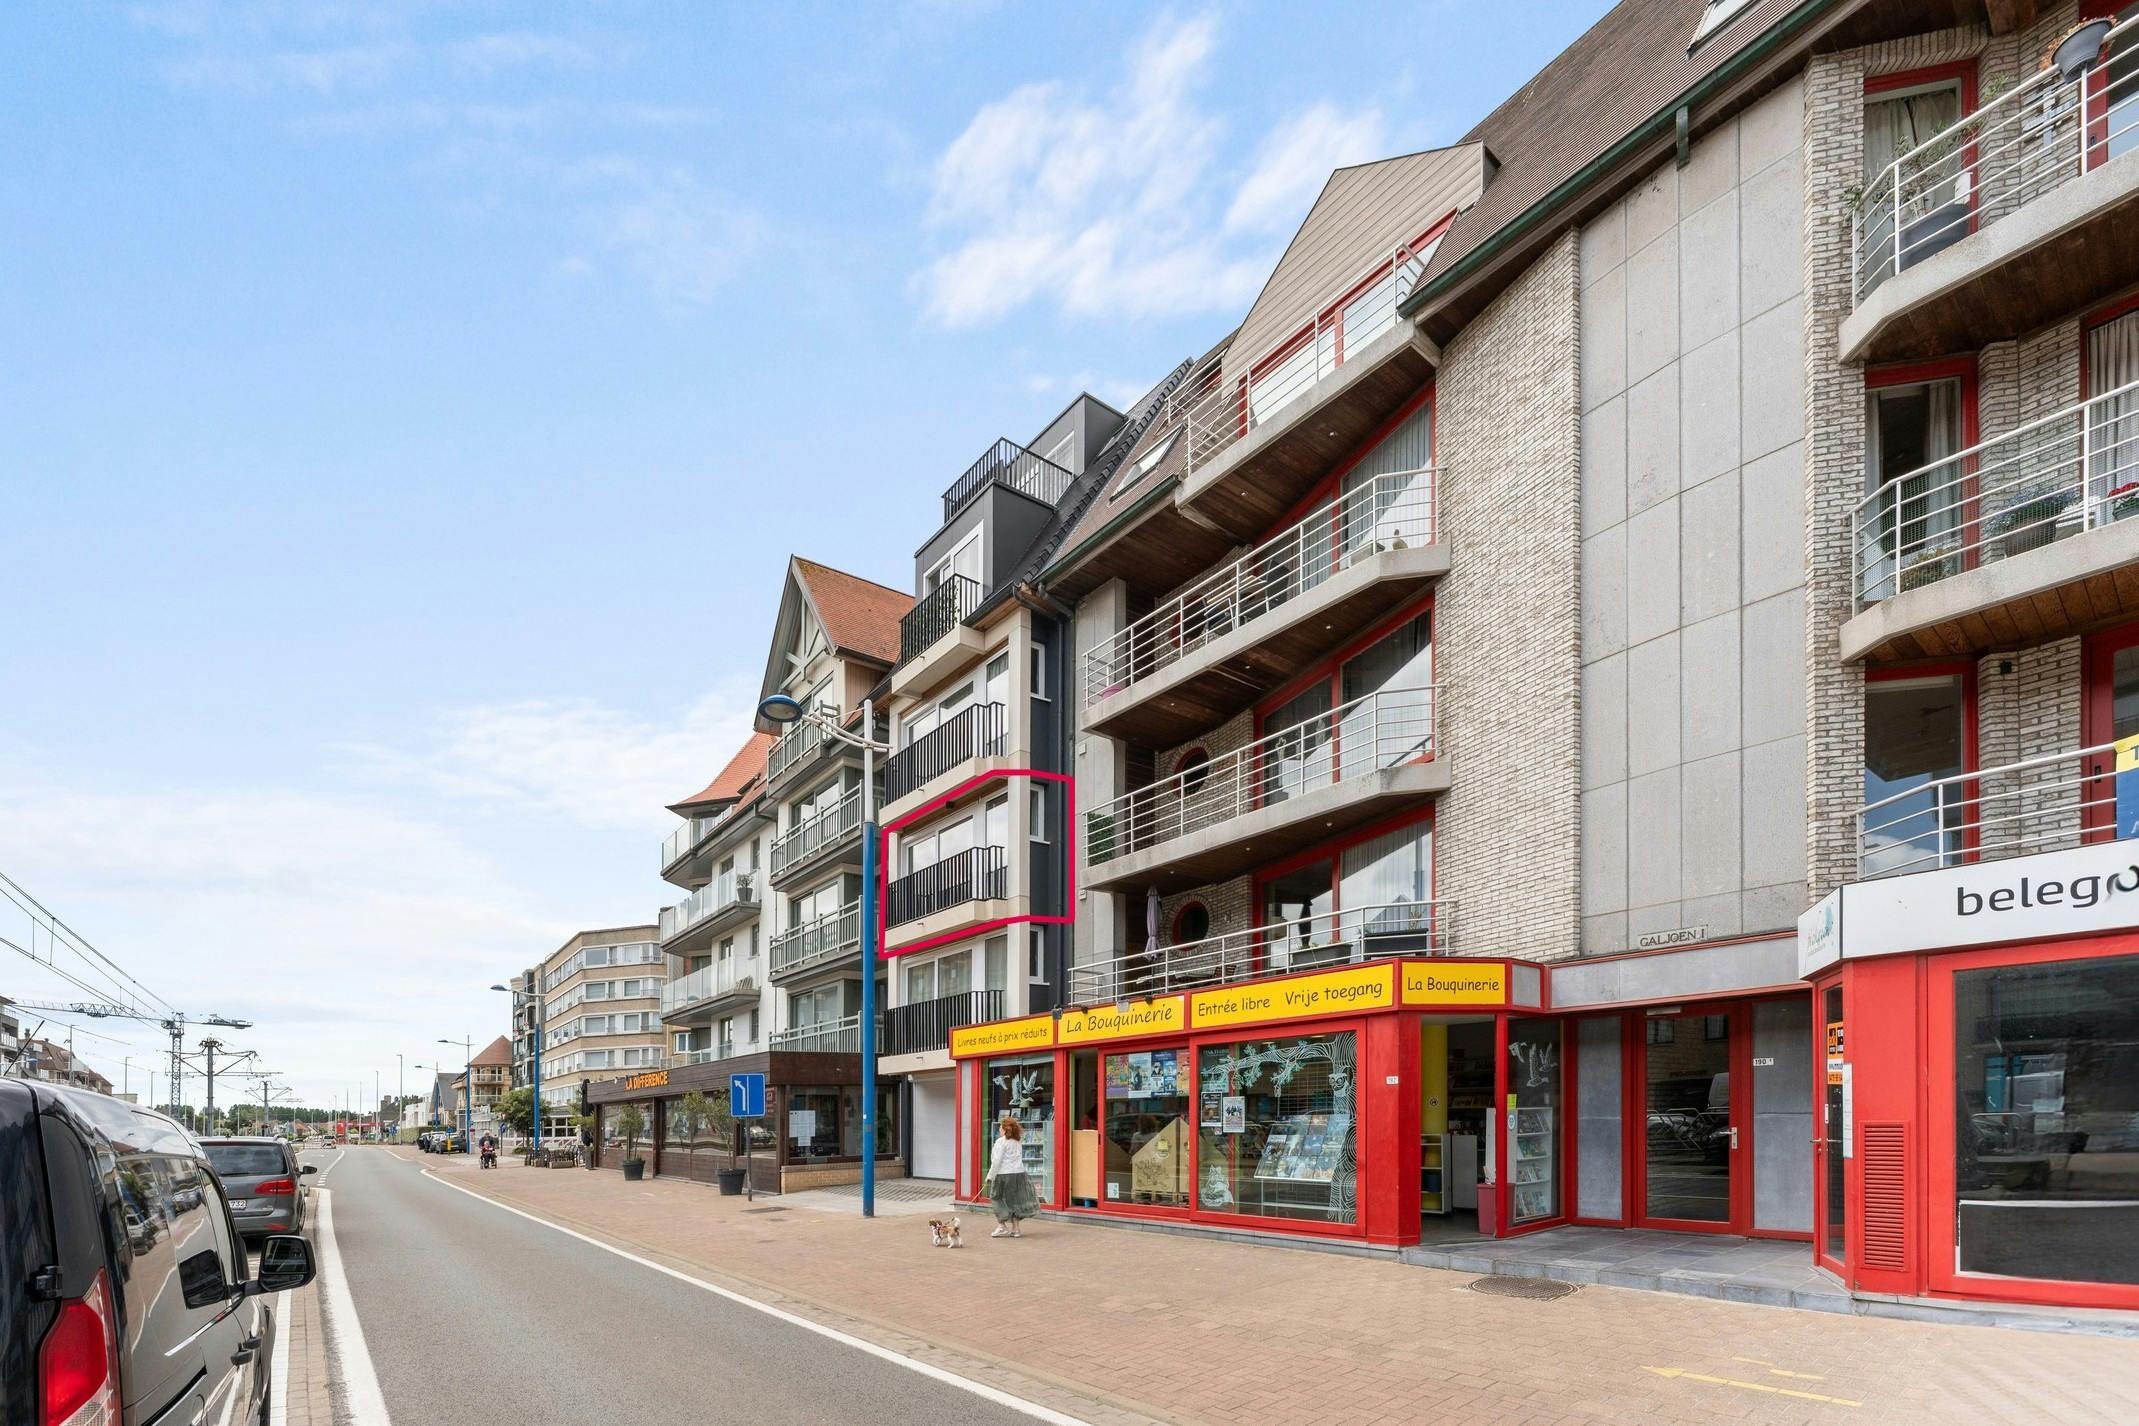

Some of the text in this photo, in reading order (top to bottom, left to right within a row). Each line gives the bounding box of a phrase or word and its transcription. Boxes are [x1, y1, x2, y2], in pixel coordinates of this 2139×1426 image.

[1640, 930, 1696, 946] GALJOEN
[1408, 976, 1500, 994] La Bouquinerie
[1198, 982, 1383, 1017] Entrée libre Vrije toegang
[1066, 1004, 1173, 1033] La Bouquinerie
[957, 1027, 1048, 1048] Livres neufs à prix réduits
[624, 1077, 634, 1091] LA
